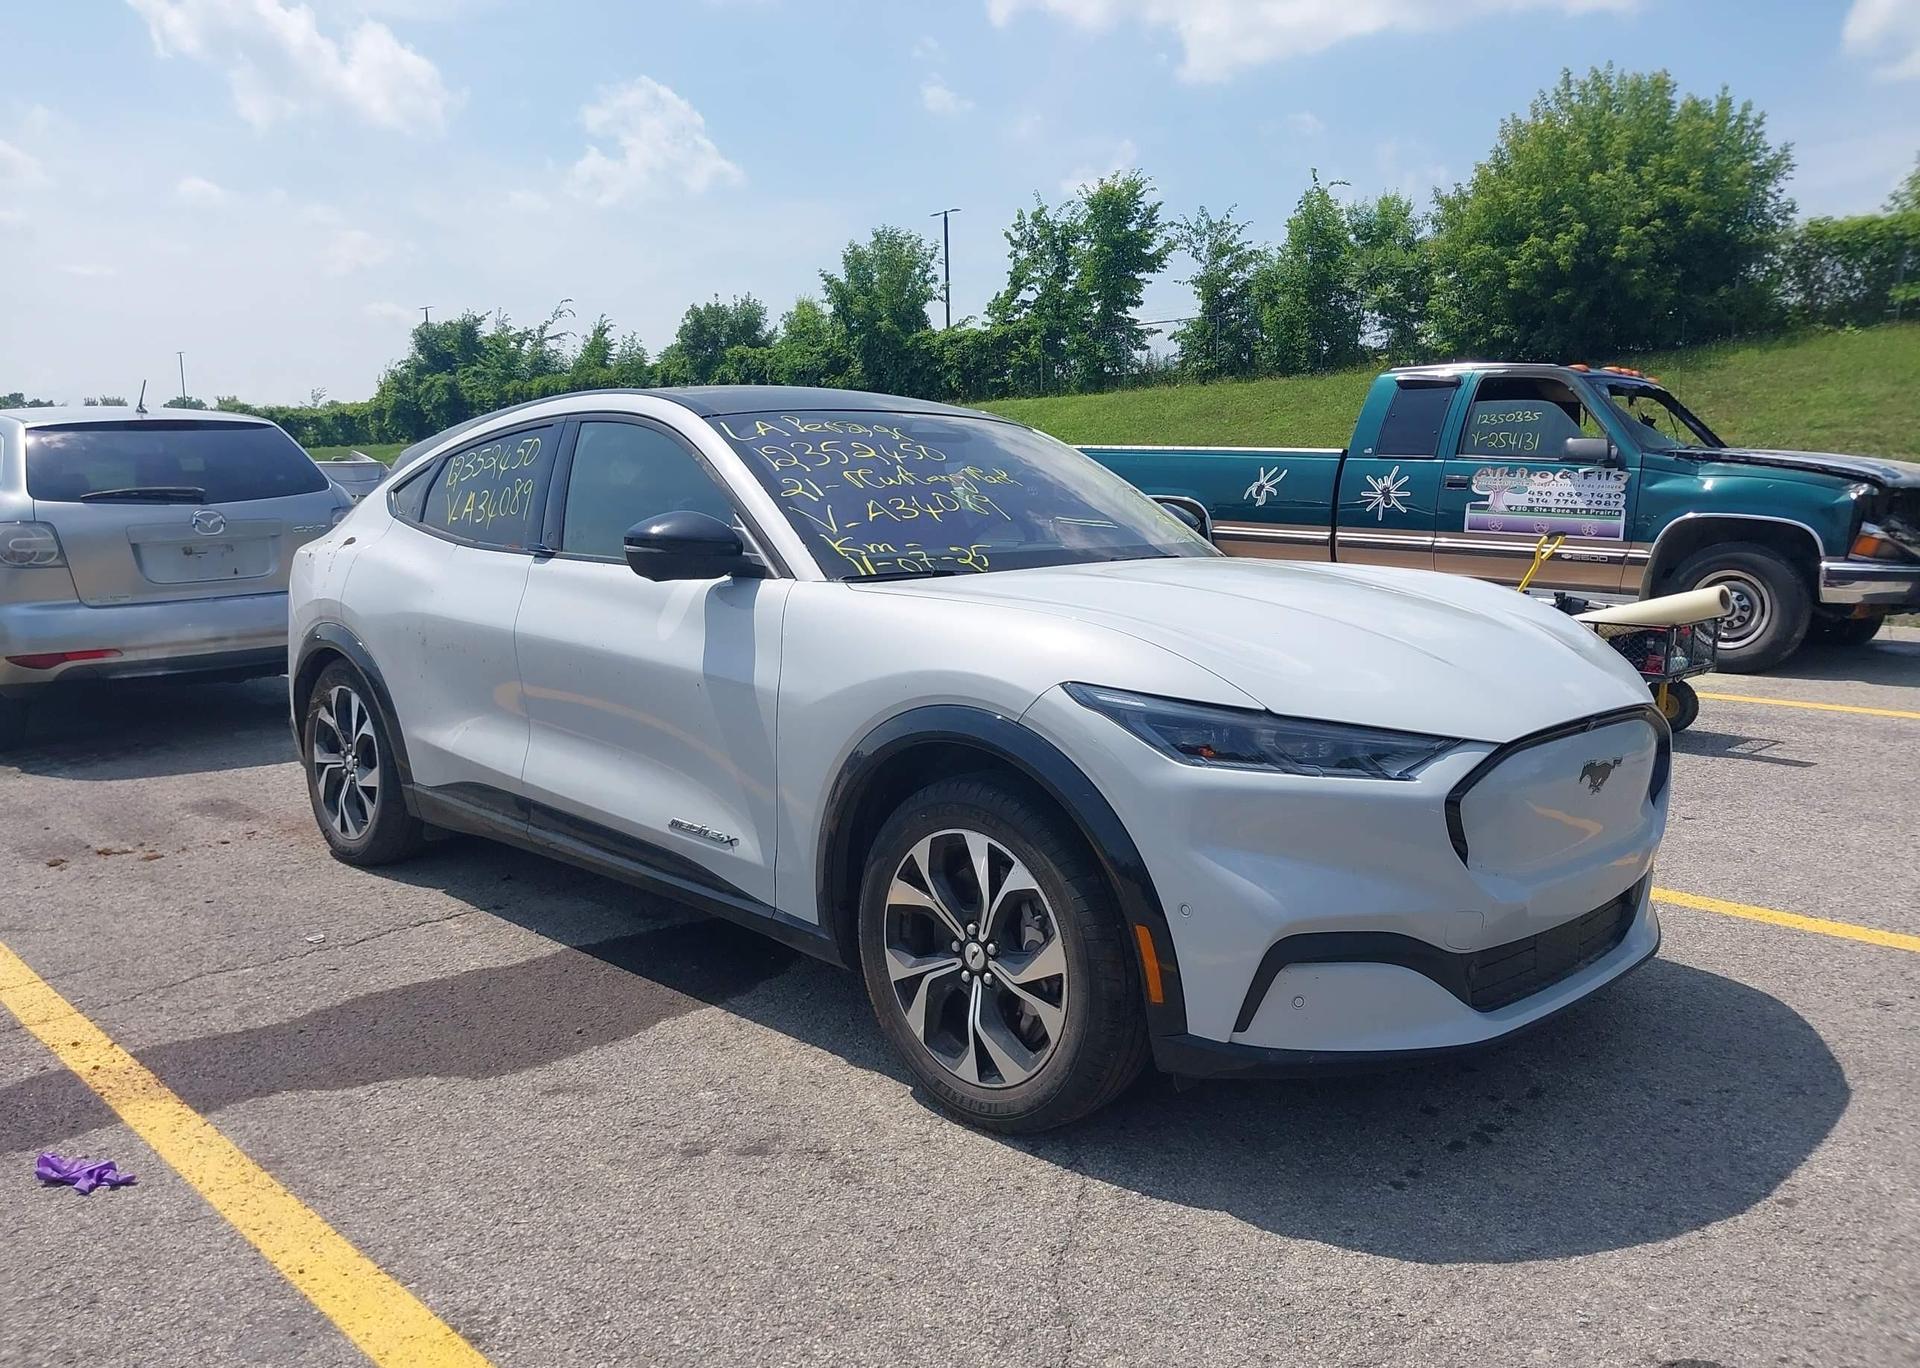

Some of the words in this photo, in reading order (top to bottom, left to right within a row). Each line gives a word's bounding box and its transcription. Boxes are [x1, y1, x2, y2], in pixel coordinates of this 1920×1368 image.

[1477, 411, 1543, 425] 12350335
[753, 440, 947, 472] 12352450
[446, 438, 541, 493] 12352450
[1583, 471, 1625, 482] Fils
[1553, 499, 1621, 508] 774-2987
